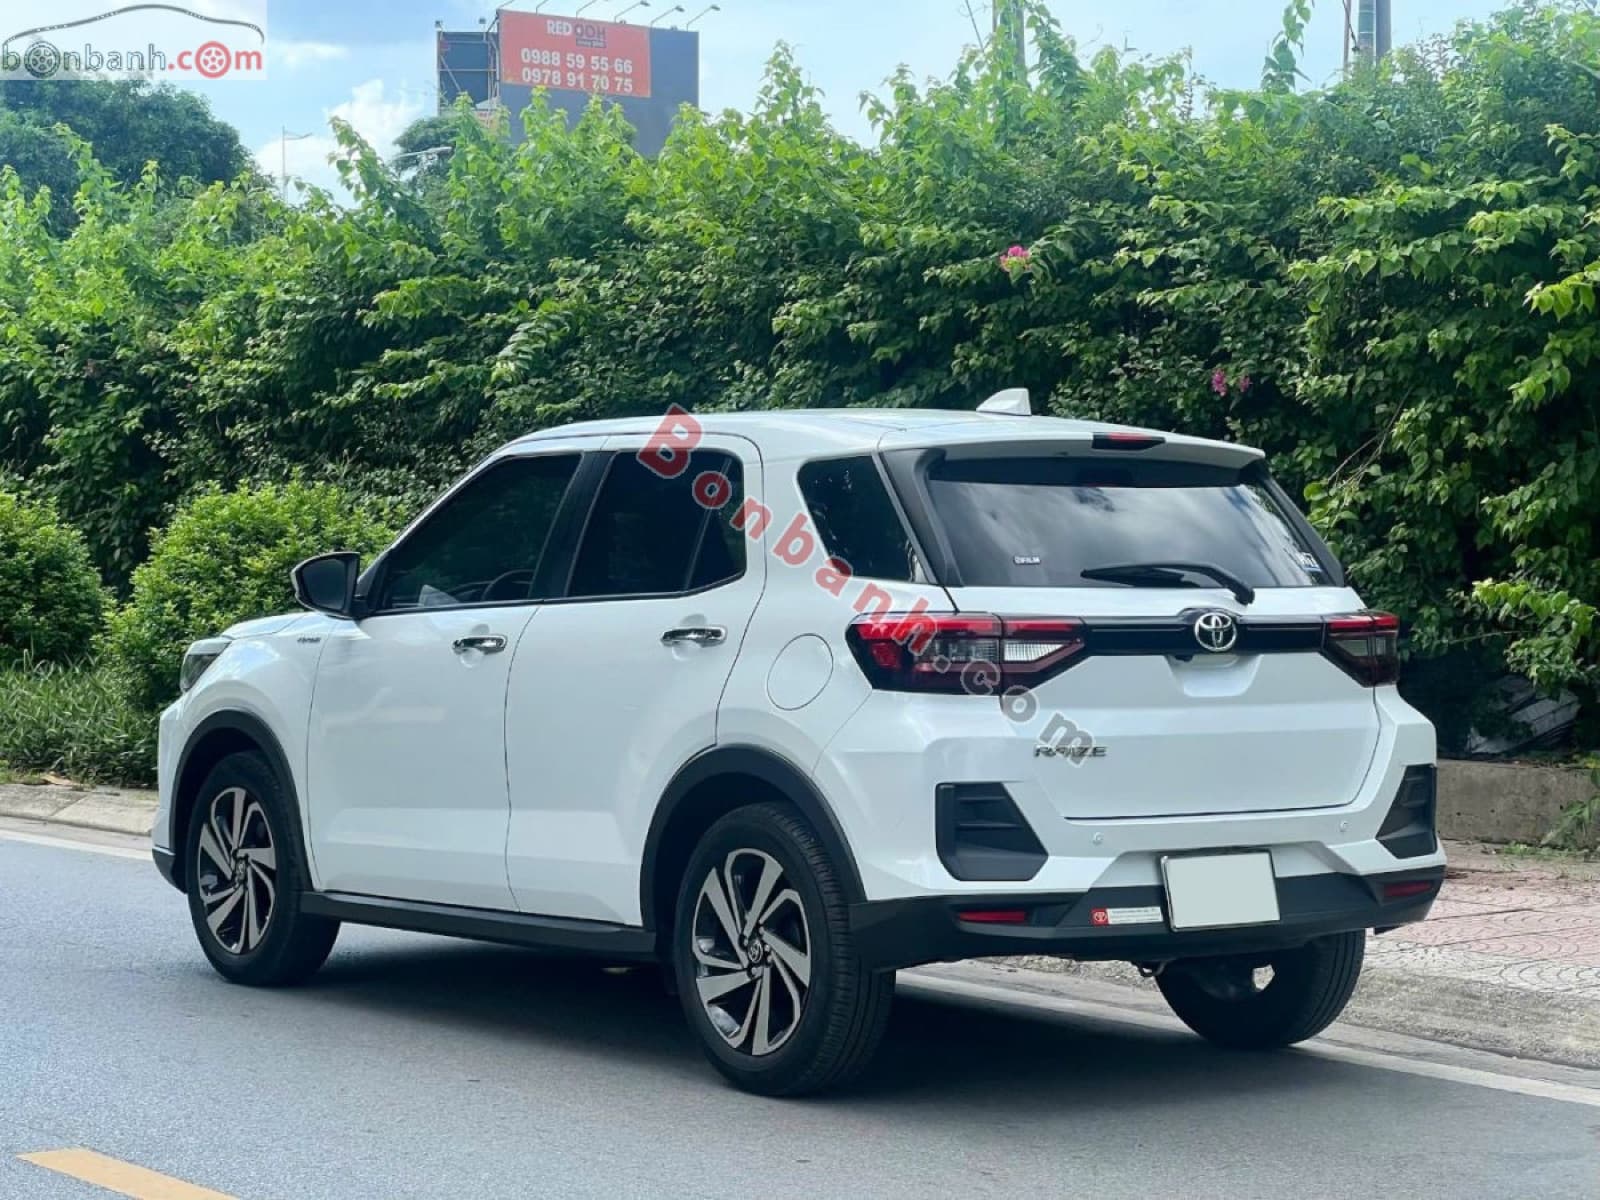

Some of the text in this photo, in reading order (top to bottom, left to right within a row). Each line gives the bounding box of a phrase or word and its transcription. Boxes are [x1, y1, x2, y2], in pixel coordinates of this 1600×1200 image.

[546, 19, 606, 39] RED OOH
[520, 47, 632, 74] 0988 59 55 66
[522, 67, 632, 93] 0978 91 70 75
[1034, 746, 1106, 758] RAIZE
